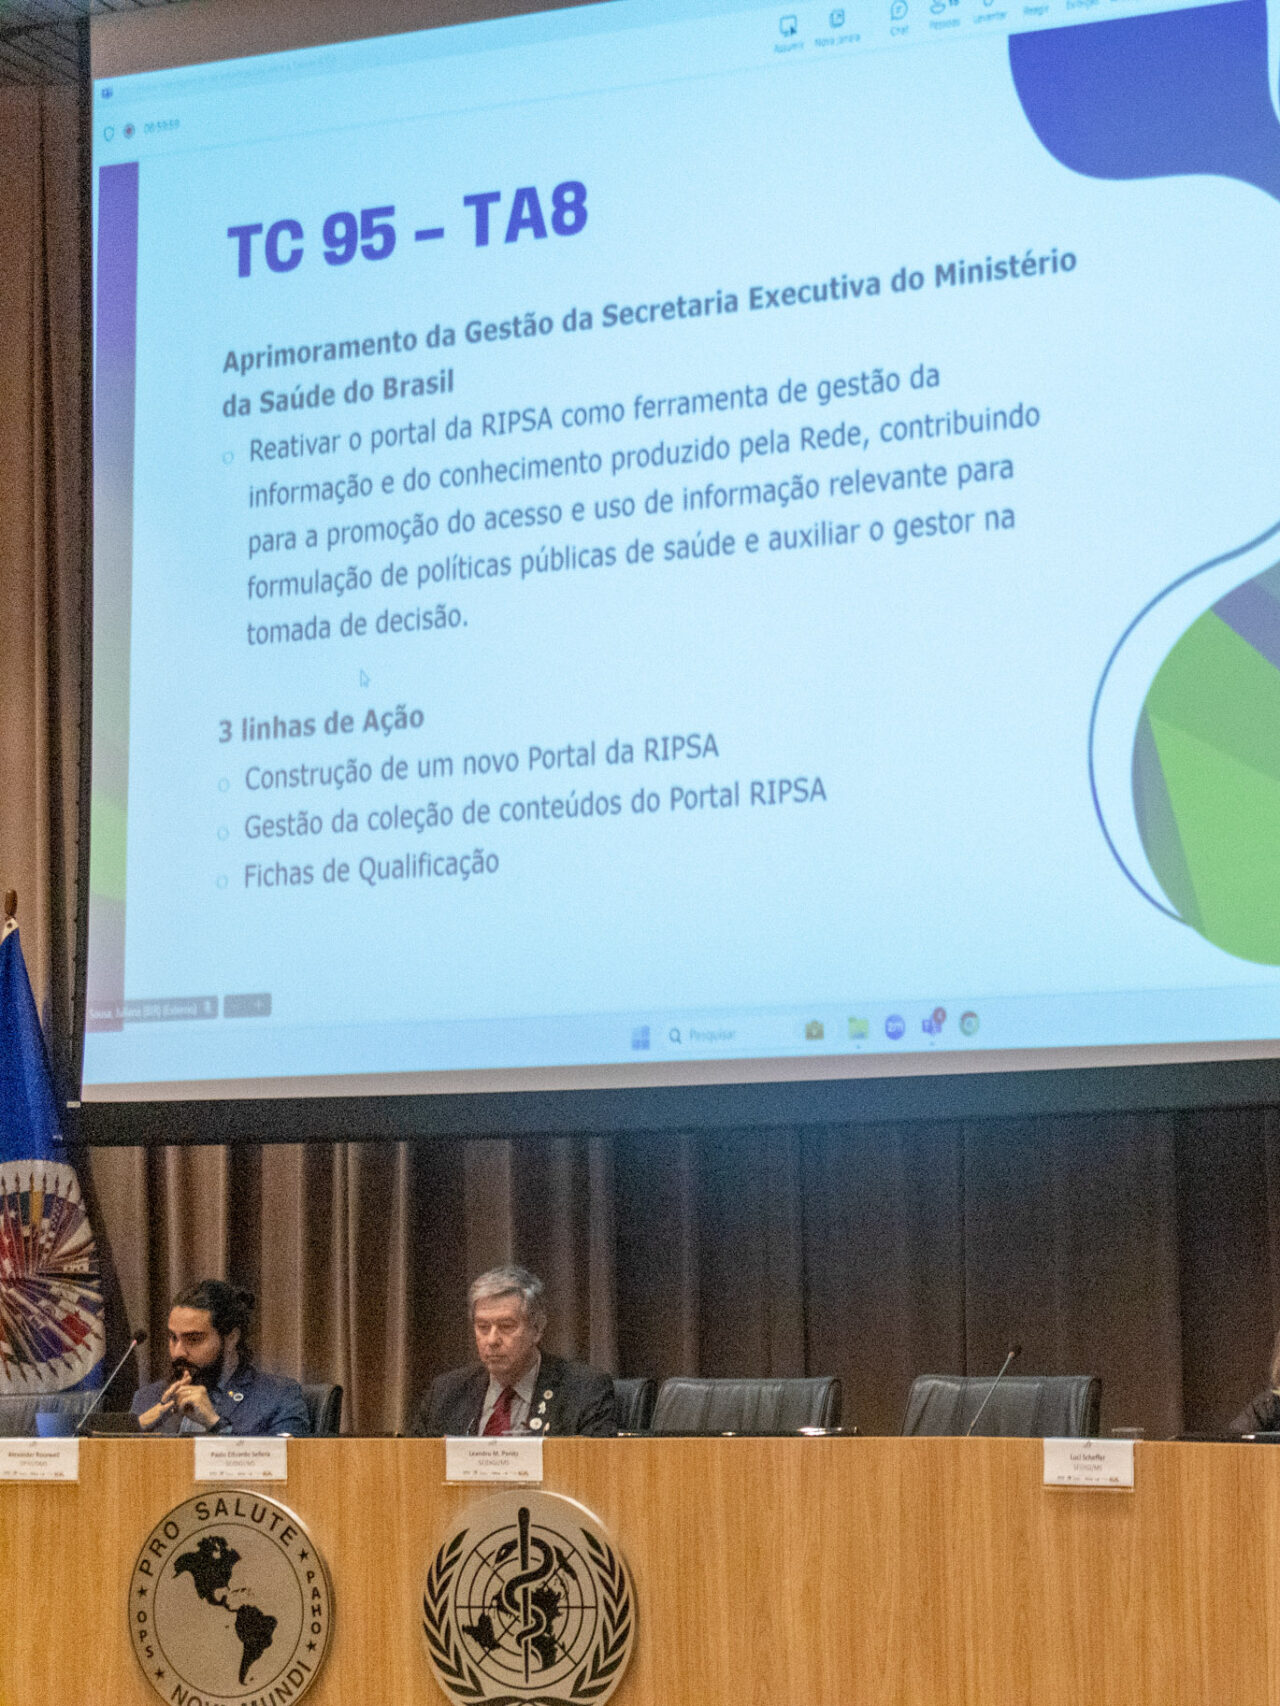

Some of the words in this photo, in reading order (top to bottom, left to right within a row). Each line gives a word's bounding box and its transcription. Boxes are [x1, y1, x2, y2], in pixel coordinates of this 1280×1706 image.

[227, 218, 304, 277] TC
[321, 205, 397, 267] 95
[463, 180, 588, 247] TA8
[222, 328, 417, 377] Aprimoramento
[425, 323, 456, 350] da
[464, 311, 554, 345] Gestão
[562, 306, 594, 333] da
[602, 289, 739, 328] Secretaria
[749, 275, 882, 312] Executiva
[891, 266, 925, 294] do
[934, 247, 1078, 289] Ministério
[222, 393, 251, 418] da
[258, 385, 336, 415] Saúde
[343, 379, 375, 405] do
[383, 368, 455, 401] Brasil
[249, 432, 341, 463] Reativar
[349, 430, 362, 452] o
[370, 418, 436, 455] portal
[445, 415, 472, 442] da
[481, 406, 553, 438] RIPSA
[561, 401, 625, 429] como
[633, 384, 769, 421] ferramenta
[777, 378, 808, 405] de
[816, 368, 901, 407] gestão
[909, 363, 941, 391] da
[248, 472, 373, 510] informação
[381, 473, 394, 495] e
[402, 467, 431, 494] do
[438, 450, 602, 490] conhecimento
[611, 436, 730, 477] produzido
[739, 428, 791, 464] pela
[799, 421, 871, 453] Rede,
[879, 401, 1041, 445] contribuindo
[248, 529, 297, 560] para
[305, 527, 318, 549] a
[326, 512, 440, 552] promoção
[447, 508, 476, 536] do
[483, 502, 563, 532] acesso
[571, 499, 586, 522] e
[594, 495, 636, 520] uso
[644, 488, 674, 515] de
[682, 474, 820, 512] informação
[829, 463, 948, 497] relevante
[957, 457, 1015, 489] para
[247, 565, 373, 601] formulação
[380, 562, 409, 588] de
[416, 553, 512, 589] políticas
[520, 544, 617, 580] públicas
[624, 538, 655, 564] de
[663, 530, 736, 561] saúde
[744, 531, 760, 553] e
[768, 519, 861, 551] auxiliar
[869, 520, 885, 543] o
[893, 508, 976, 545] gestor
[984, 507, 1016, 532] na
[246, 611, 332, 646] tomada
[339, 612, 368, 638] de
[375, 602, 470, 635] decisão.
[217, 721, 234, 744] 3
[240, 711, 317, 742] linhas
[323, 710, 355, 736] de
[362, 703, 426, 738] Ação
[244, 756, 373, 792] Construção
[380, 755, 410, 783] de
[416, 756, 454, 779] um
[462, 750, 520, 777] novo
[527, 741, 597, 772] Portal
[604, 738, 635, 765] da
[643, 732, 720, 763] RIPSA
[244, 808, 323, 841] Gestão
[330, 806, 360, 835] da
[366, 800, 454, 835] coleção
[461, 798, 491, 825] de
[498, 789, 623, 823] conteúdos
[630, 787, 661, 814] do
[669, 781, 741, 812] Portal
[749, 776, 828, 807] RIPSA
[243, 860, 315, 890] Fichas
[322, 857, 351, 884] de
[358, 849, 500, 886] Qualificação
[139, 1521, 180, 1577] PRO
[195, 1497, 299, 1548] SALUTE
[136, 1610, 154, 1659] OPS
[306, 1569, 323, 1635] PAHO
